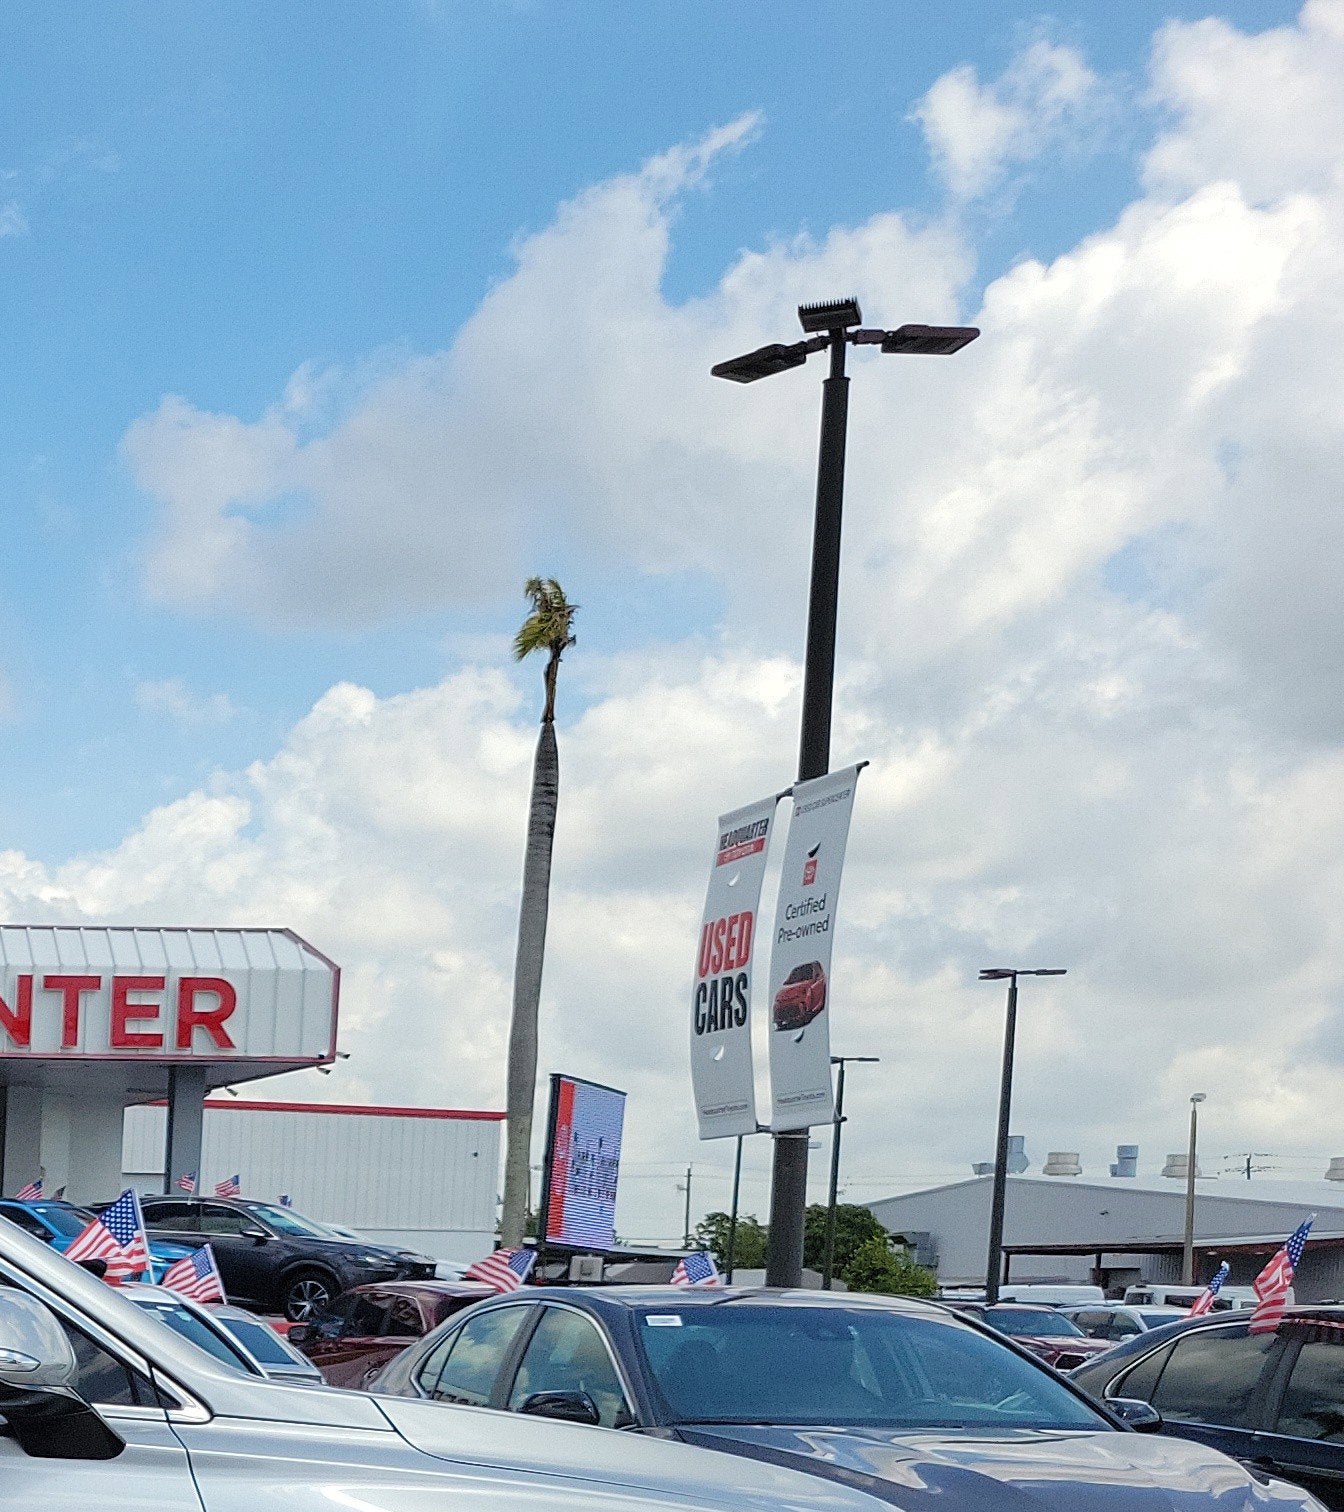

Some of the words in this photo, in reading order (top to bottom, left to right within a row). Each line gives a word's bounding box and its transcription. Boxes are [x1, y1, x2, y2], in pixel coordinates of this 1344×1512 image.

[777, 913, 830, 944] Pre-owned
[785, 892, 827, 921] Certified
[698, 910, 754, 978] USED
[694, 972, 748, 1036] CARS
